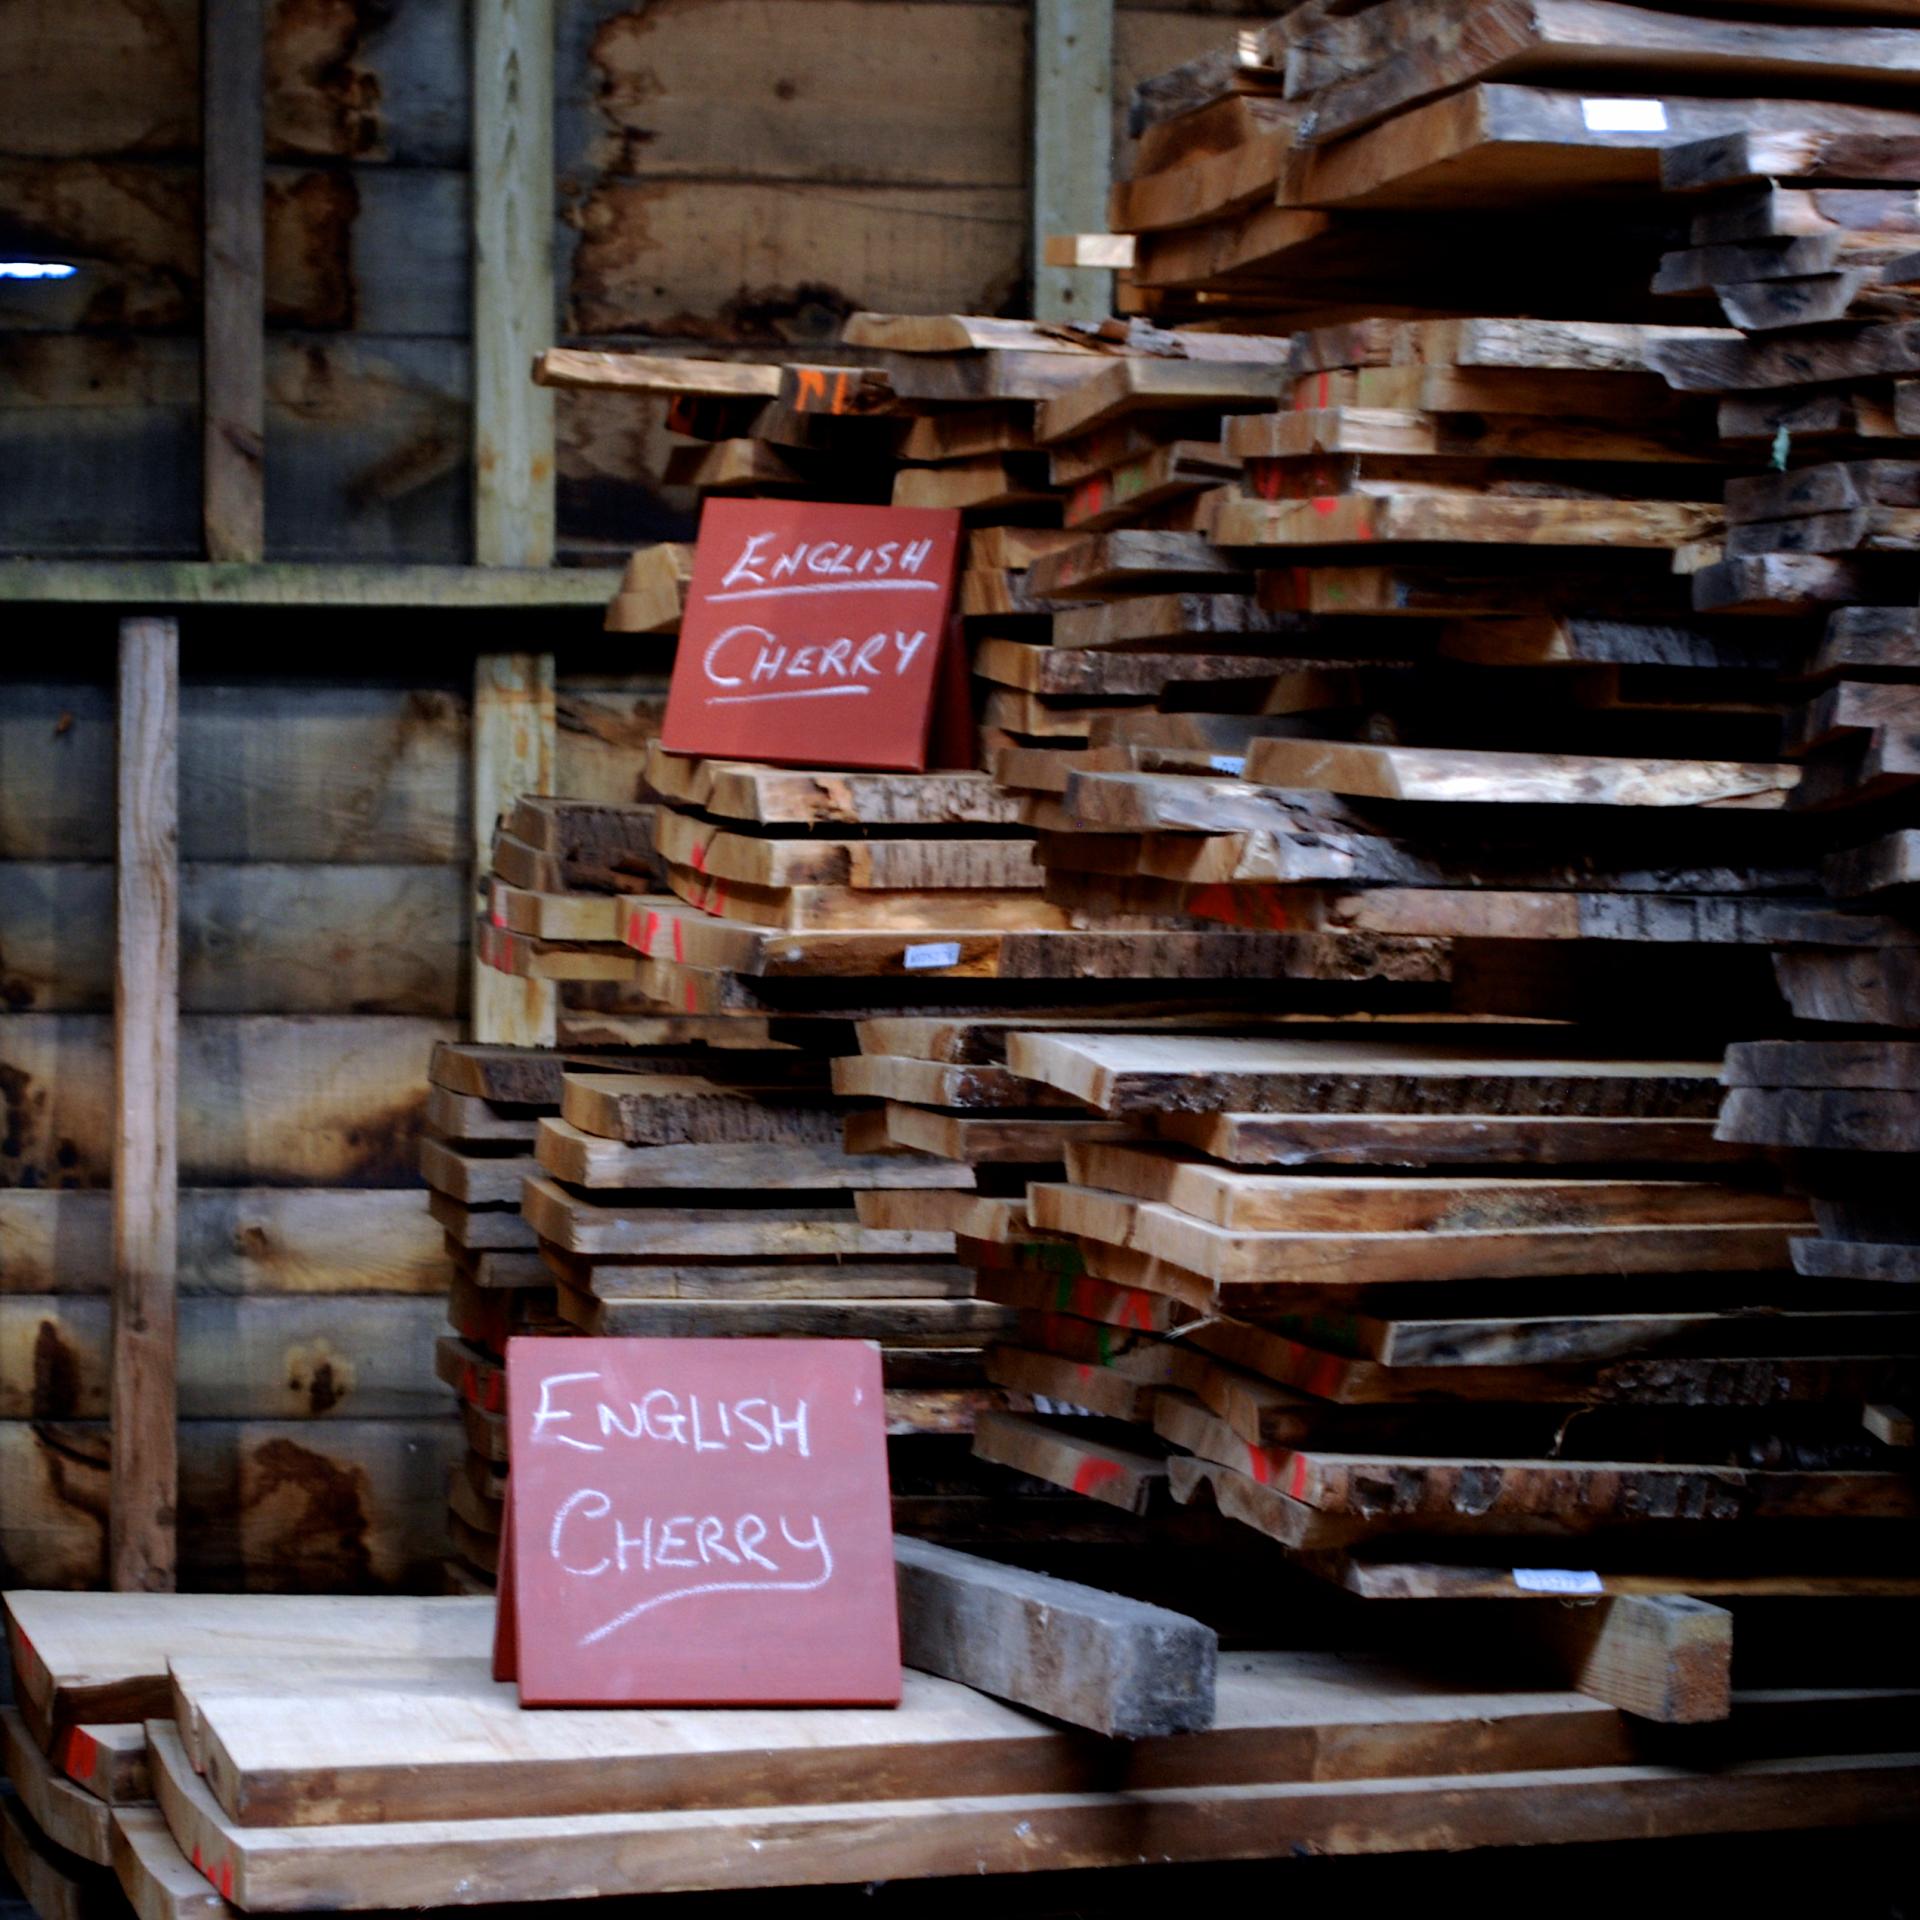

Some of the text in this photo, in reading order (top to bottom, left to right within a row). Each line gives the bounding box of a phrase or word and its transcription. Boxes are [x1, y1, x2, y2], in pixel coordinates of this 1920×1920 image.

[721, 531, 934, 588] ENGLISH
[704, 623, 928, 688] CHERRY
[529, 1371, 810, 1458] ENGLISH
[550, 1488, 834, 1591] CHERRY
